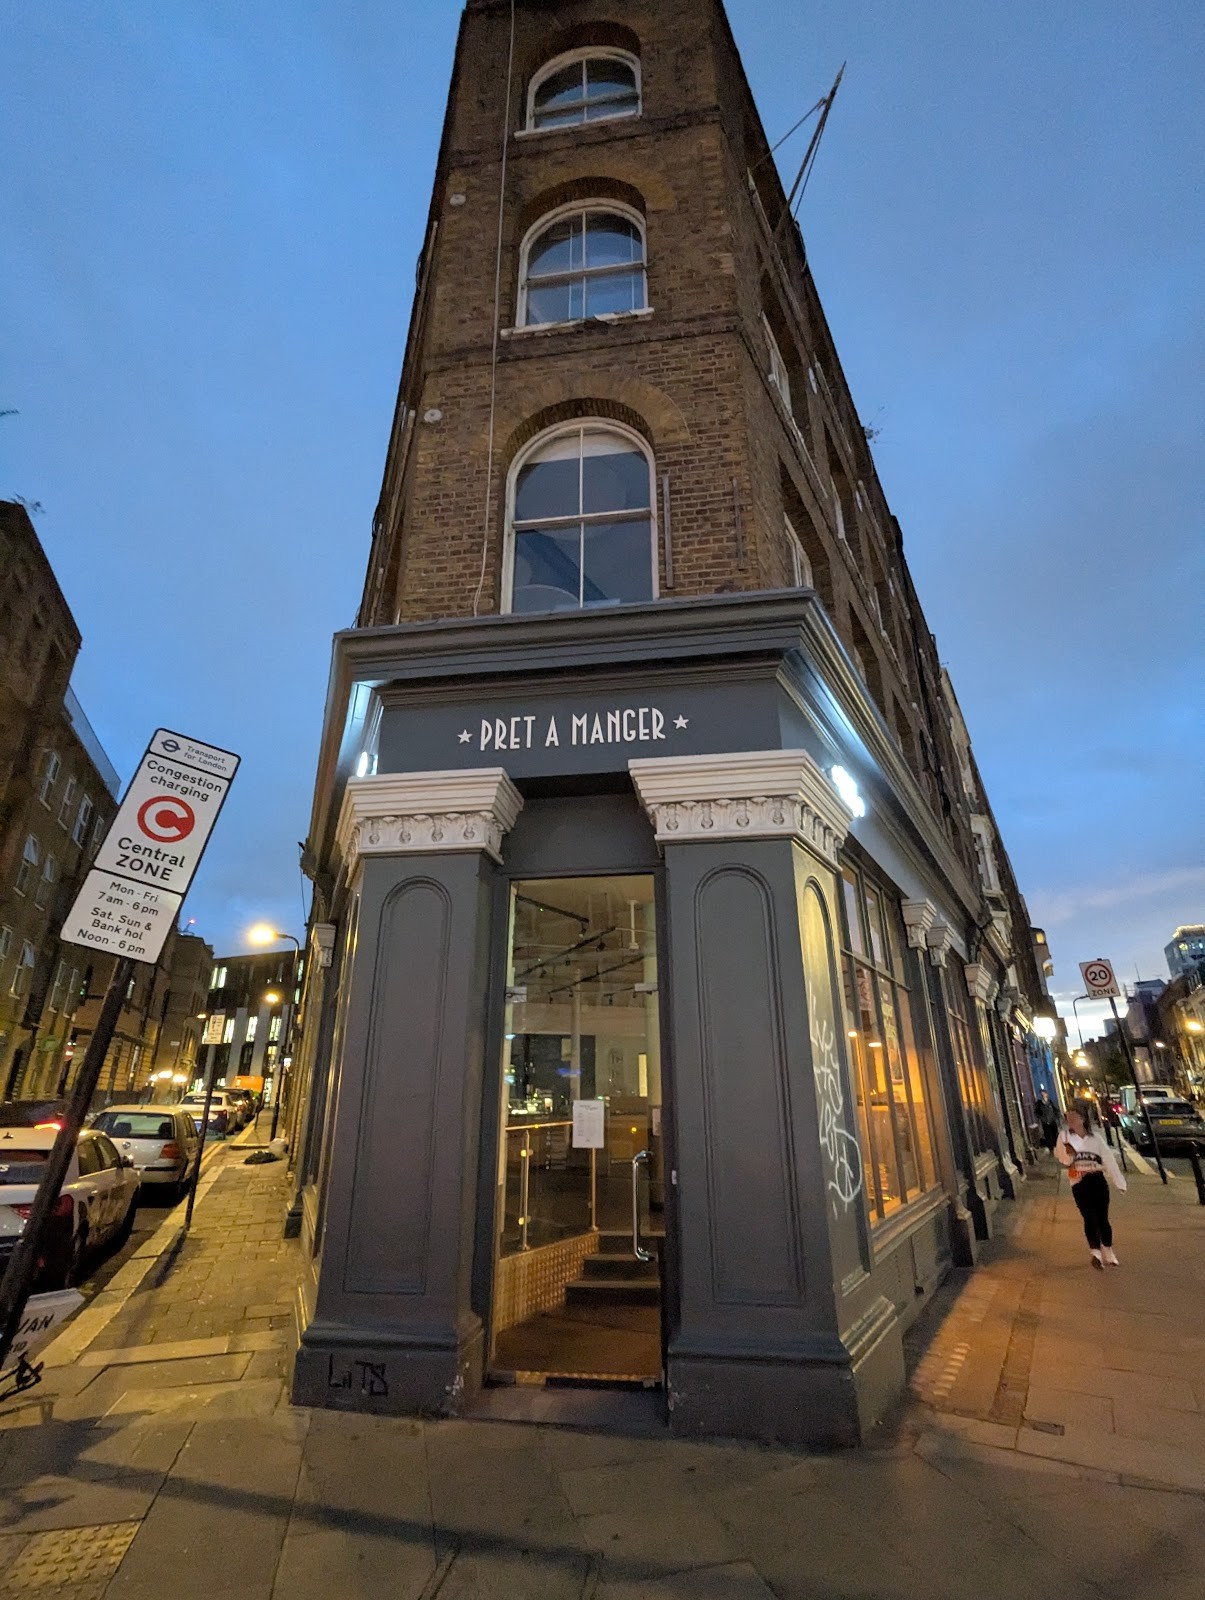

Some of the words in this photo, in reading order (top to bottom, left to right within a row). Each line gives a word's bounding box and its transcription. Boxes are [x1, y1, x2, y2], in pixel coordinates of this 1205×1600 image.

[480, 715, 536, 751] PRET
[544, 715, 560, 747] A
[571, 707, 666, 746] MANGER
[184, 752, 197, 760] for
[198, 756, 227, 772] London
[187, 745, 226, 764] Transport
[147, 760, 222, 793] Congestion
[150, 775, 210, 802] charging
[118, 837, 186, 868] Central
[116, 854, 173, 881] ZONE
[109, 881, 134, 896] Mon
[143, 891, 159, 903] Fri
[91, 918, 122, 934] Bank
[124, 928, 144, 941] hol
[118, 914, 141, 928] Sun
[144, 922, 152, 931] &
[77, 928, 109, 945] Noon
[1089, 970, 1108, 981] 20
[1091, 987, 1117, 997] ZONE
